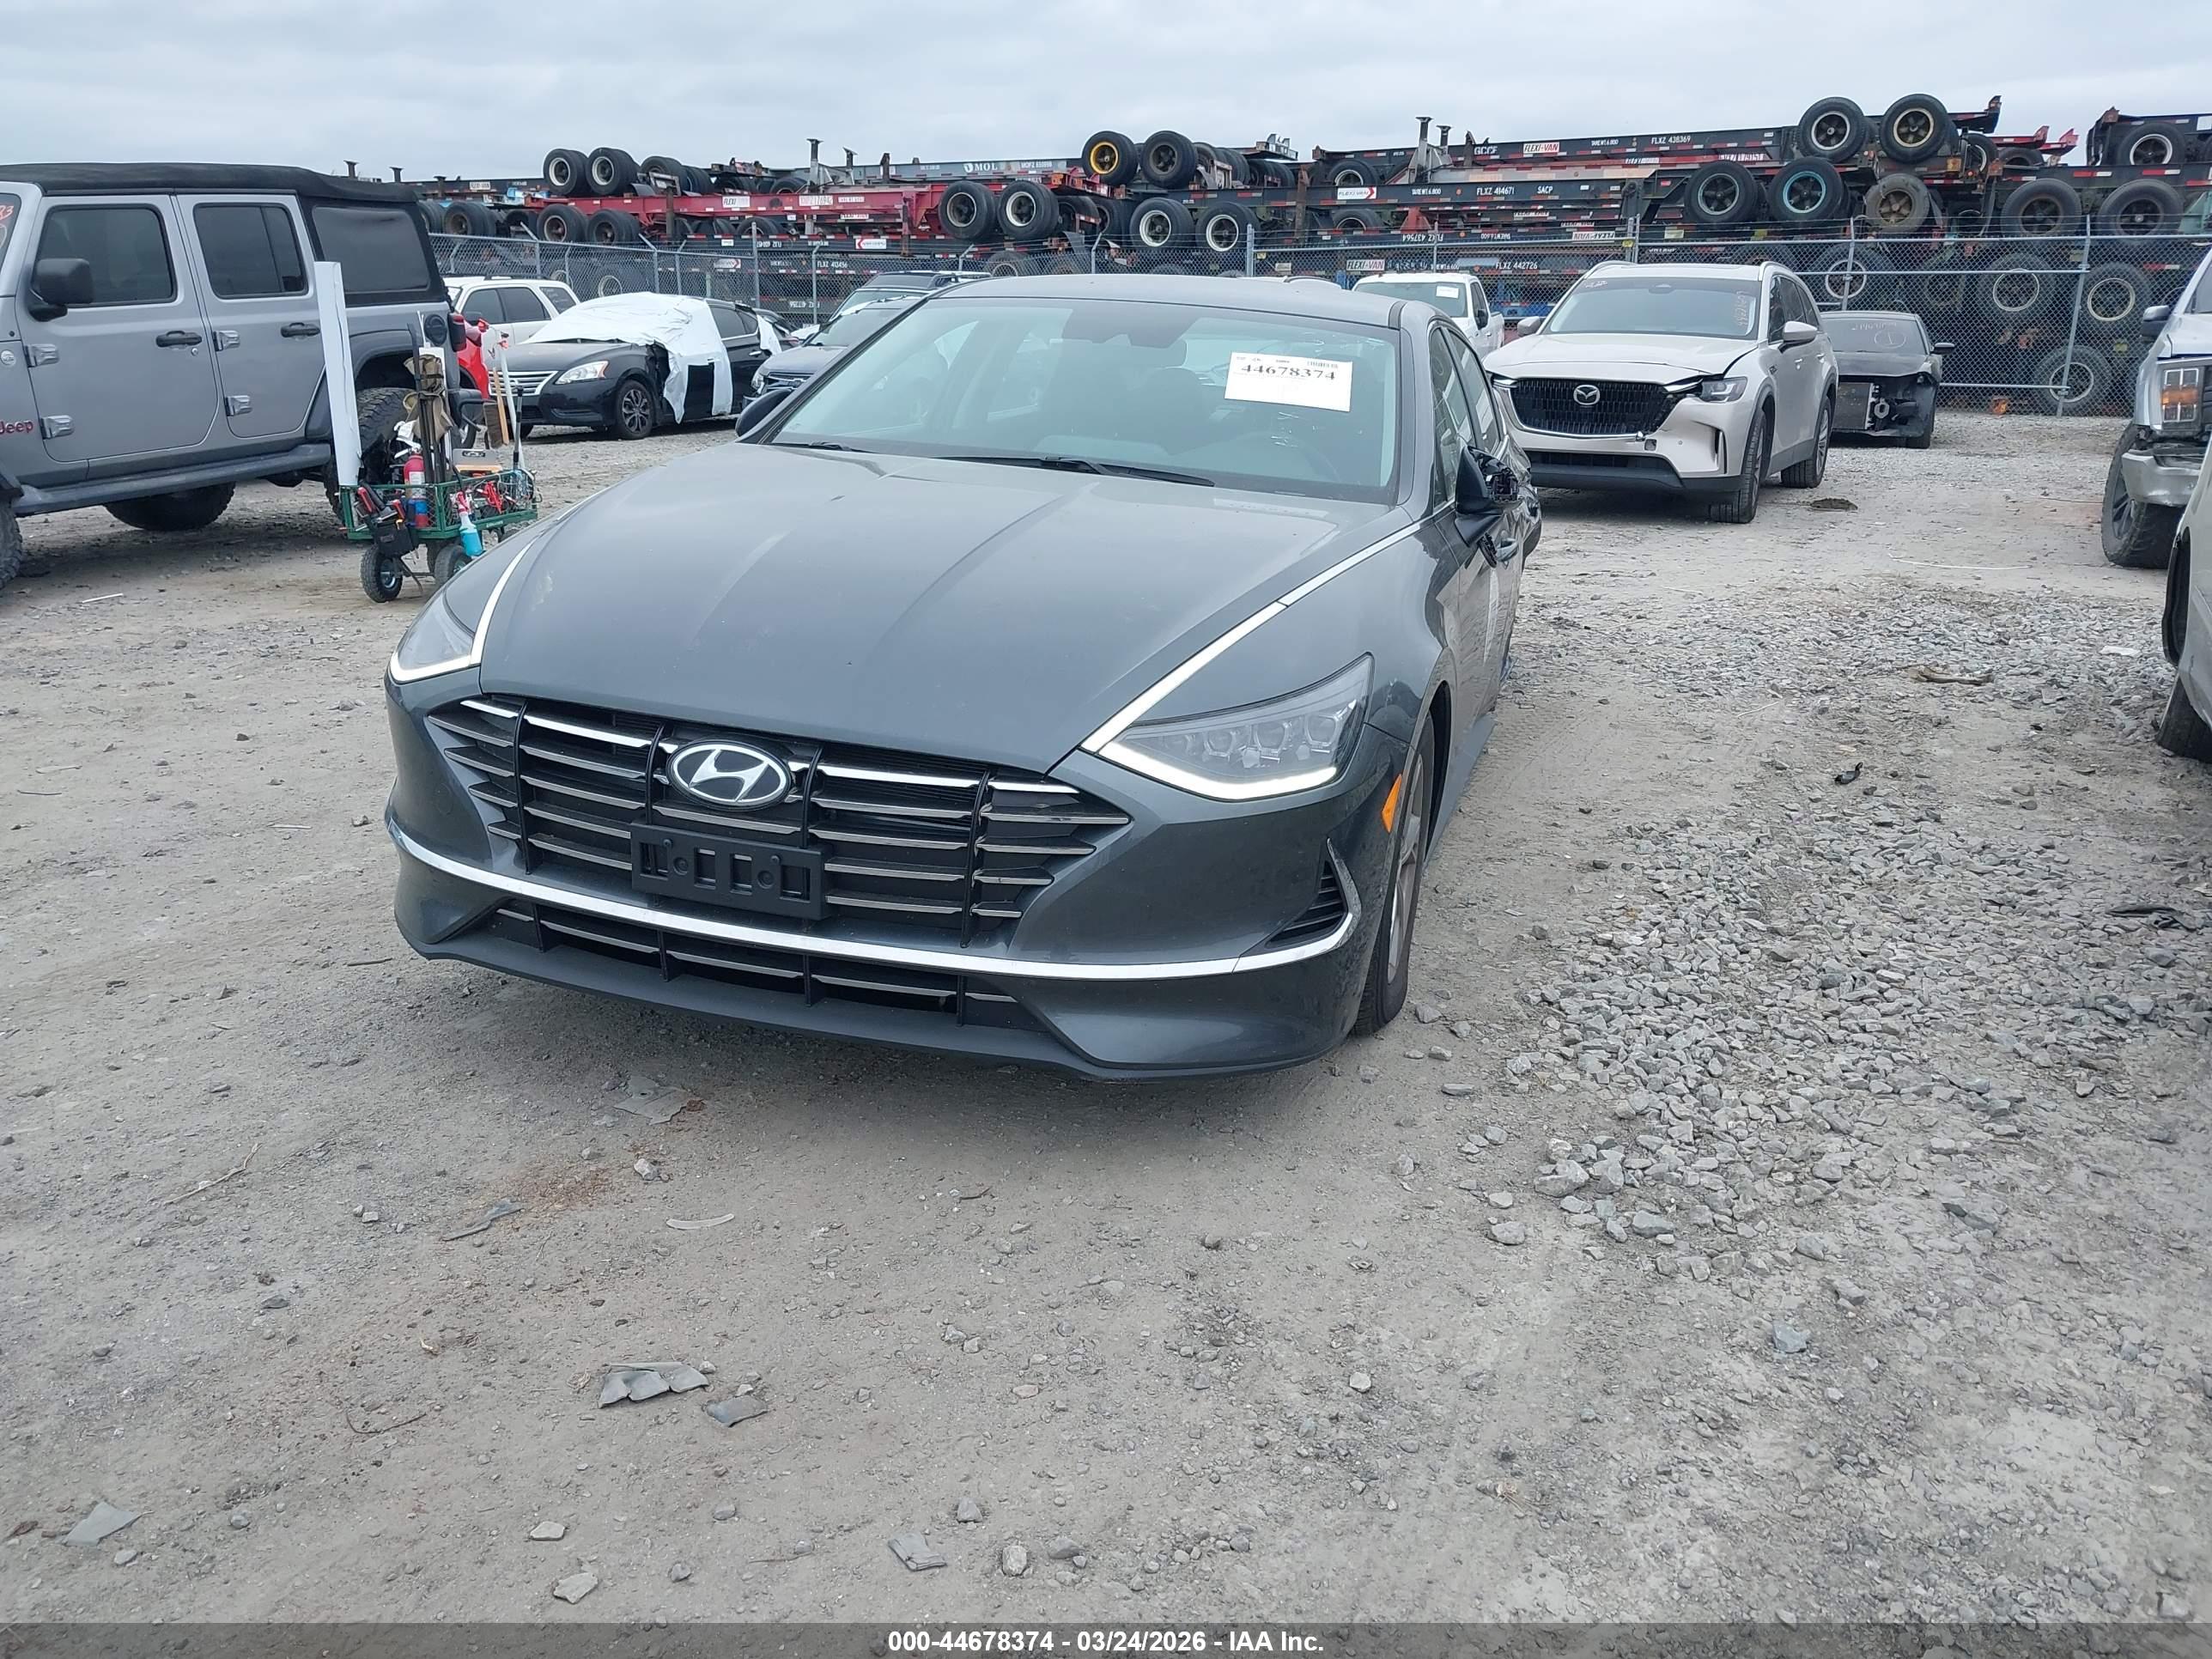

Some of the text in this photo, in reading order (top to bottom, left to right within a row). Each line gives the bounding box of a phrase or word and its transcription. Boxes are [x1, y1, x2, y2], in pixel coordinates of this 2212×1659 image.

[975, 162, 998, 171] MOL
[1477, 186, 1515, 196] FLXZ 414671
[1537, 185, 1553, 194] SACP
[1513, 261, 1538, 270] 442726
[1241, 363, 1336, 380] 44678374
